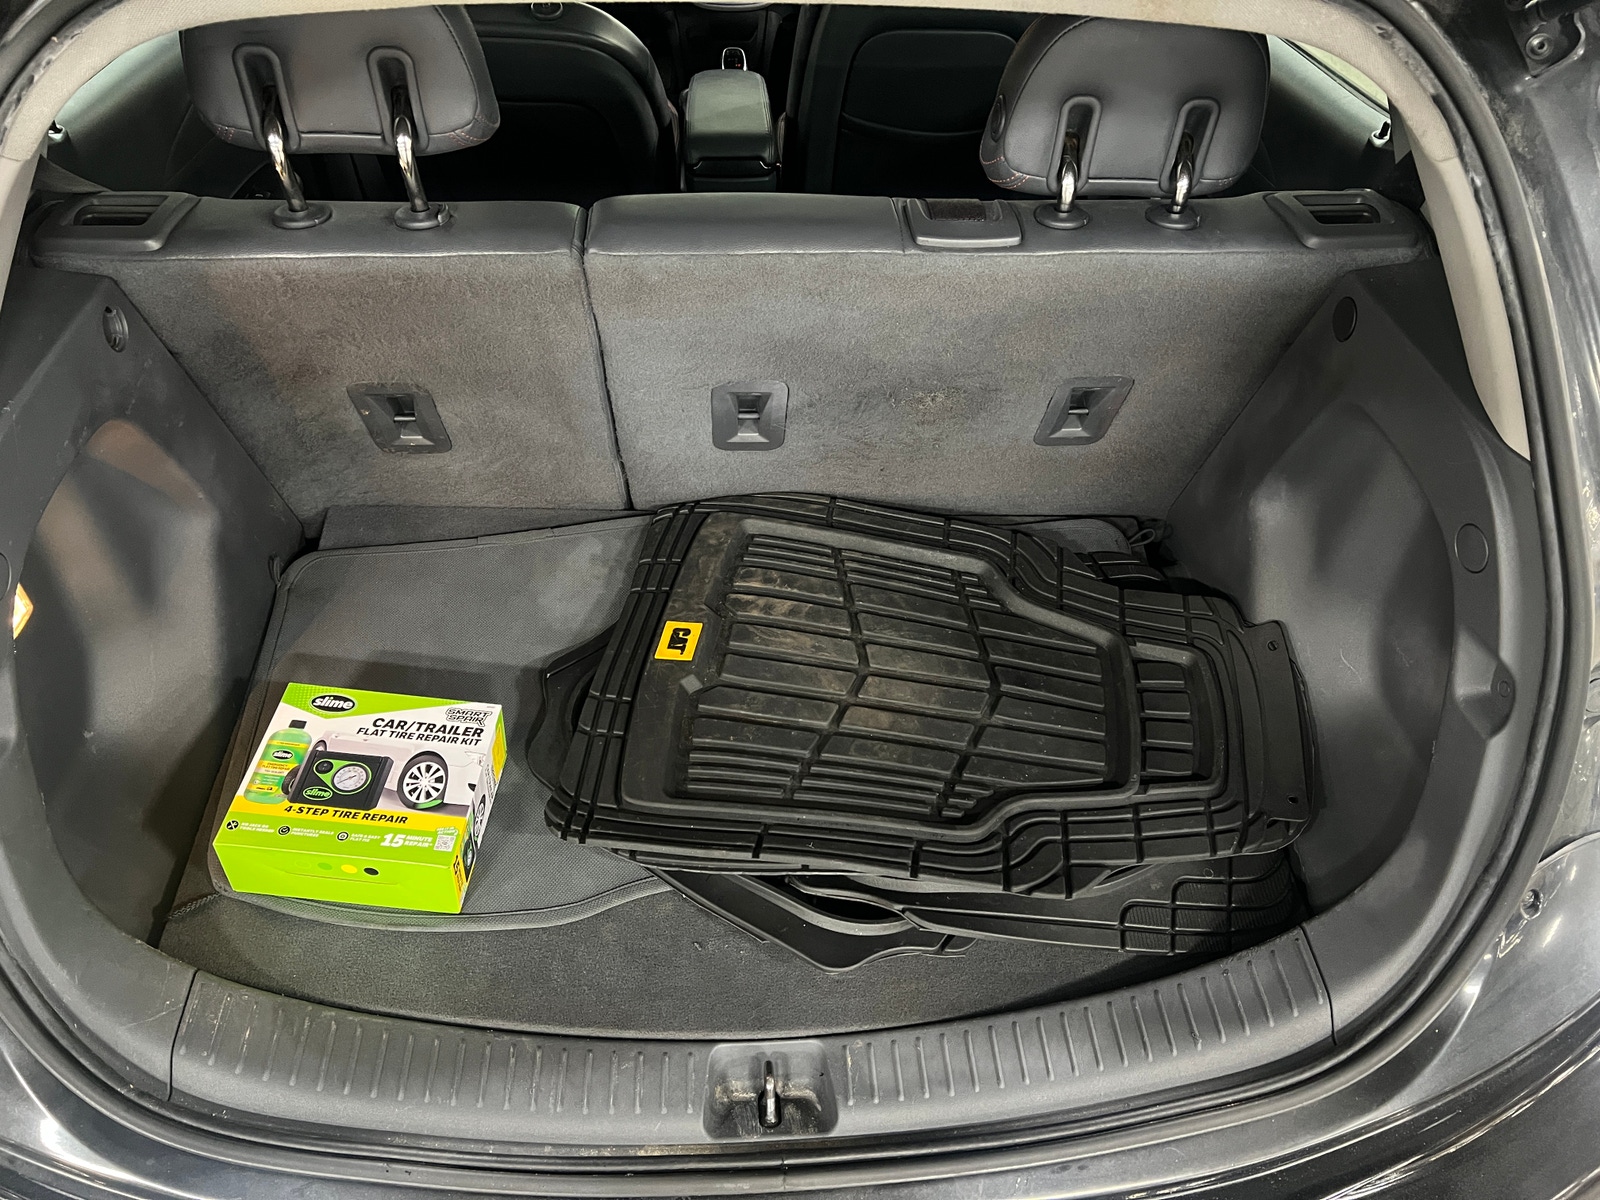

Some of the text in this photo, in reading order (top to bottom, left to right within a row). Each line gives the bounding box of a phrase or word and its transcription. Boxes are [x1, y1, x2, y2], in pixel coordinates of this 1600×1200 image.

[667, 628, 691, 655] CAT
[312, 696, 354, 709] slime
[447, 708, 491, 718] SMART
[372, 717, 484, 737] CAR/TRAILER
[447, 715, 485, 726] SPAIR
[356, 727, 482, 746] FLAT TIRE REPAIR KIT
[305, 788, 331, 798] slime
[284, 805, 408, 824] 4-STEP TIRE REPAIR
[380, 833, 406, 848] 15
[405, 834, 433, 843] MINUTE
